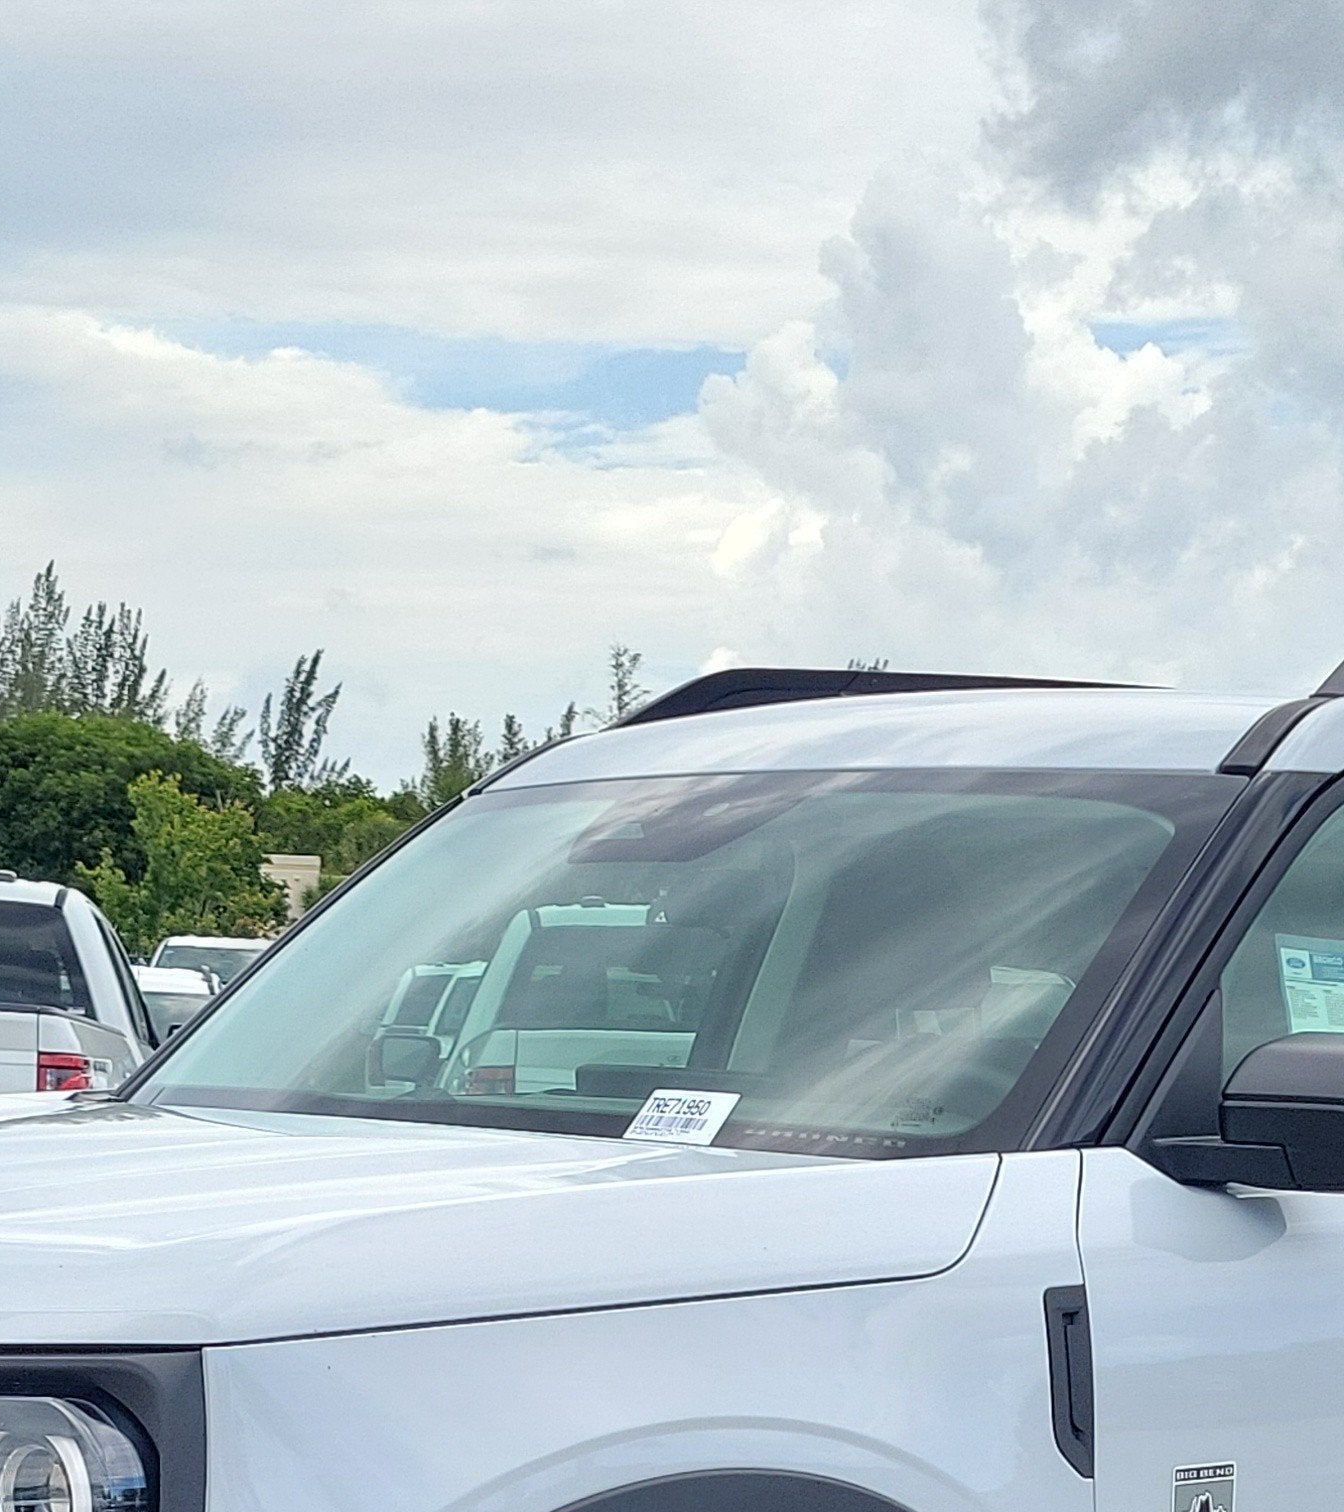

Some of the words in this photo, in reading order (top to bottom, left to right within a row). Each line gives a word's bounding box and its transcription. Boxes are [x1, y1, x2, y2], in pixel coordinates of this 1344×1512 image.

[646, 1096, 712, 1116] TRE71950
[1176, 1469, 1197, 1481] BIG
[1199, 1466, 1233, 1478] BEND
